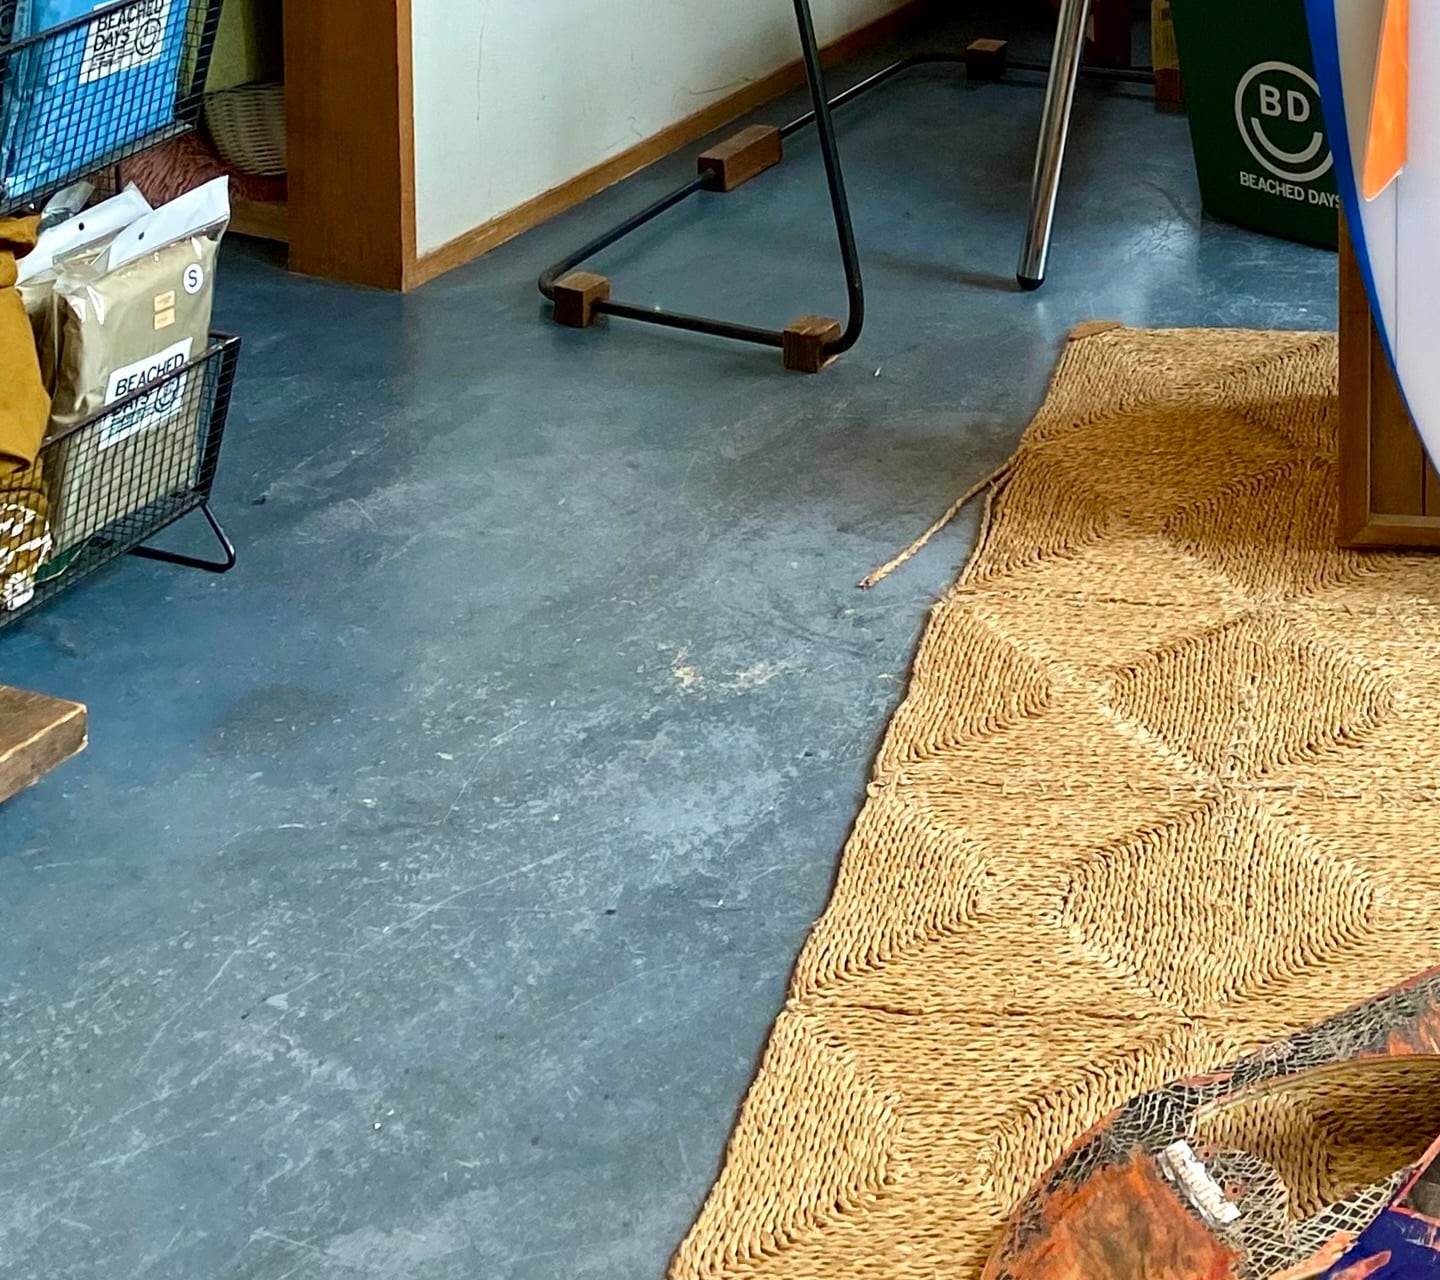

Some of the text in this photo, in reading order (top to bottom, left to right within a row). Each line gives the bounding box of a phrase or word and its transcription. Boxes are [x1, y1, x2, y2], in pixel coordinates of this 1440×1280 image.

[93, 26, 130, 52] DAYS
[1259, 83, 1311, 123] BD
[1240, 170, 1305, 201] BEACHED
[188, 269, 198, 288] S
[115, 352, 185, 397] BEACHED
